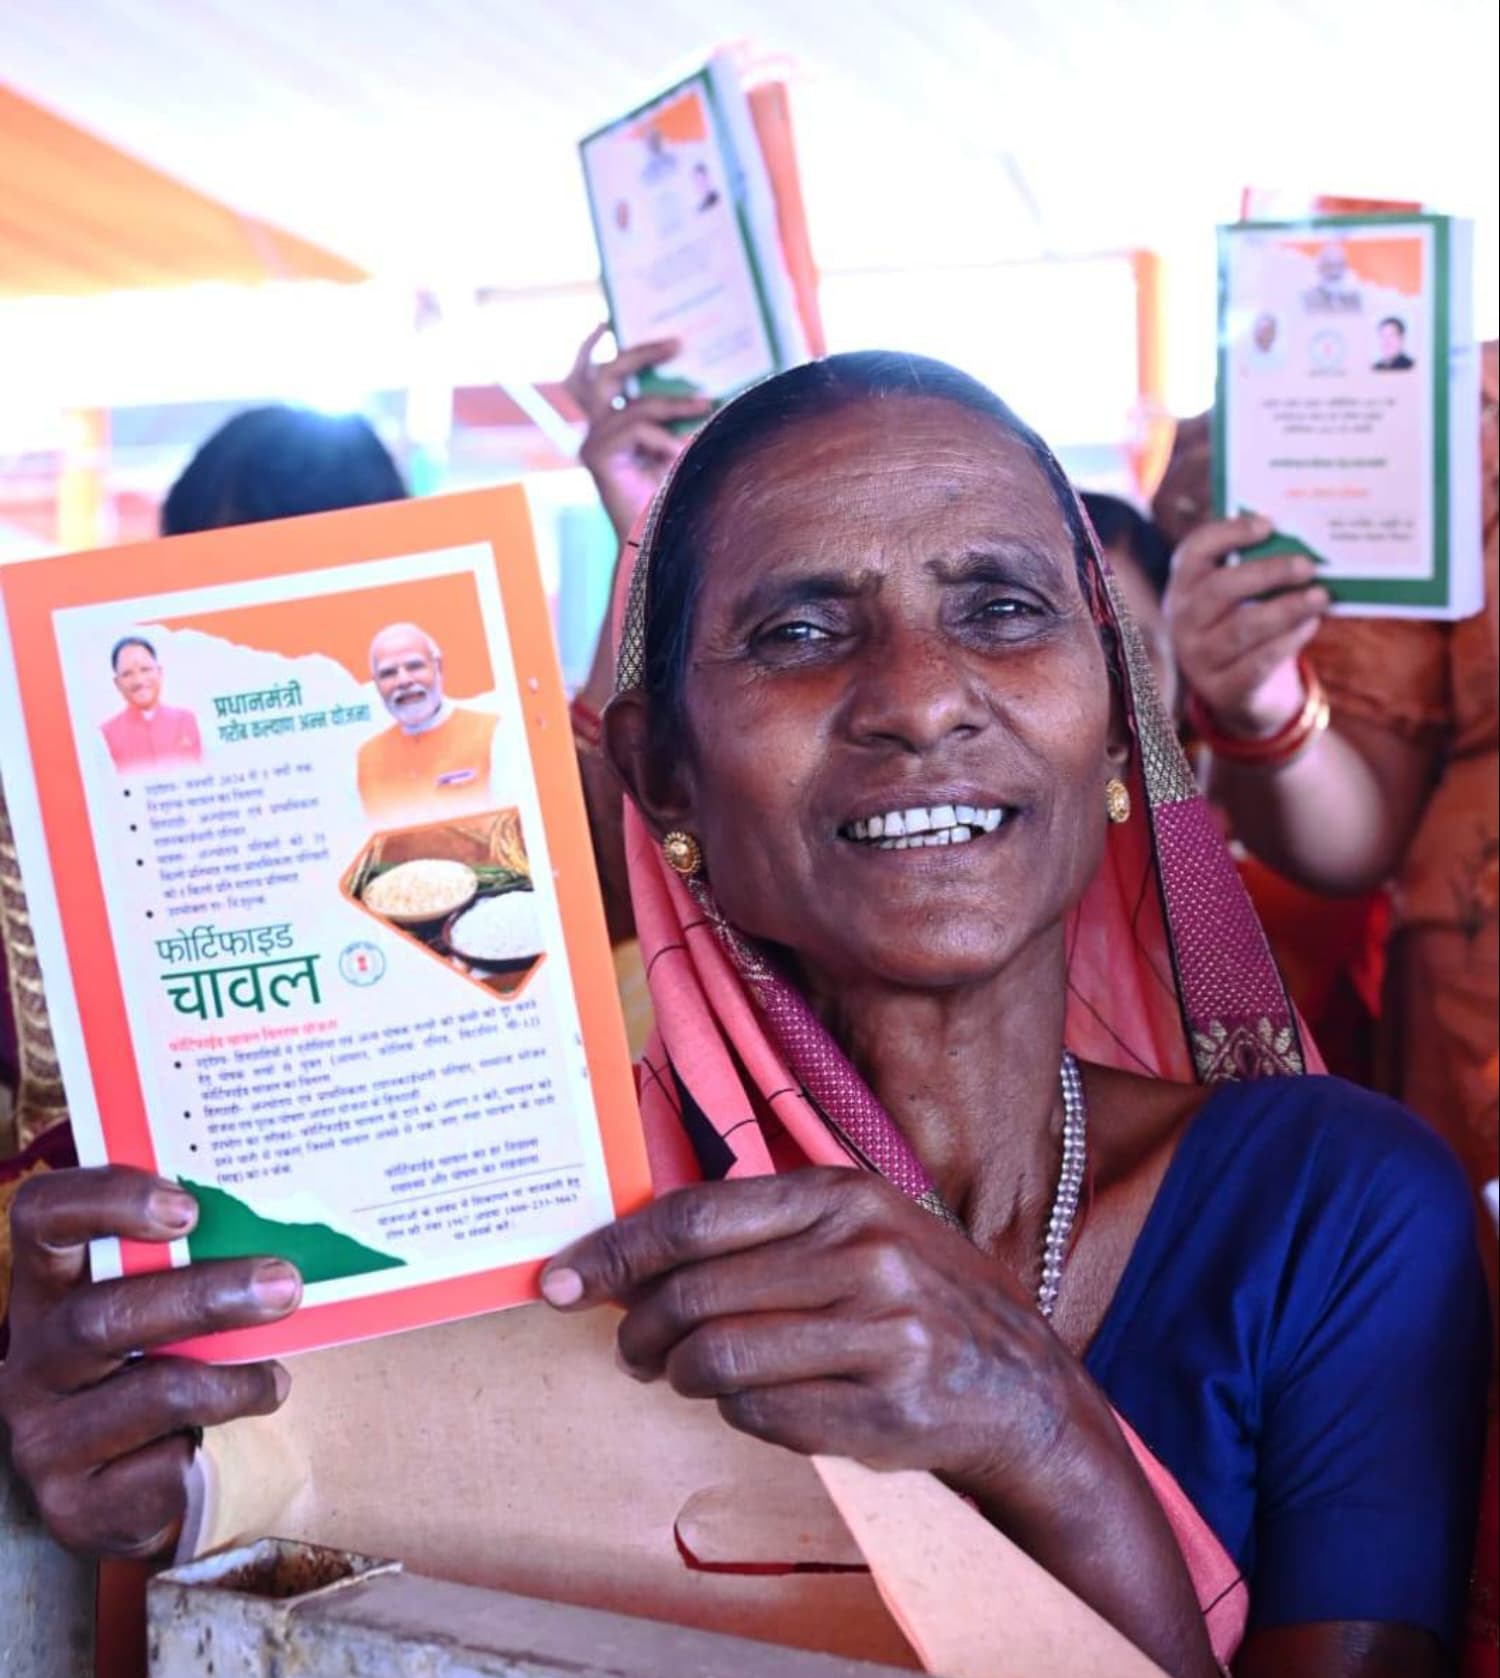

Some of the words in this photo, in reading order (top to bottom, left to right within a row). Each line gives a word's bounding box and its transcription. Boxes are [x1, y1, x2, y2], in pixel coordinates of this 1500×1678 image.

[212, 679, 302, 717] प्रधानमंत्री
[329, 704, 370, 725] योजना
[155, 922, 293, 964] फोर्टिफाइड
[160, 954, 321, 1020] चावल
